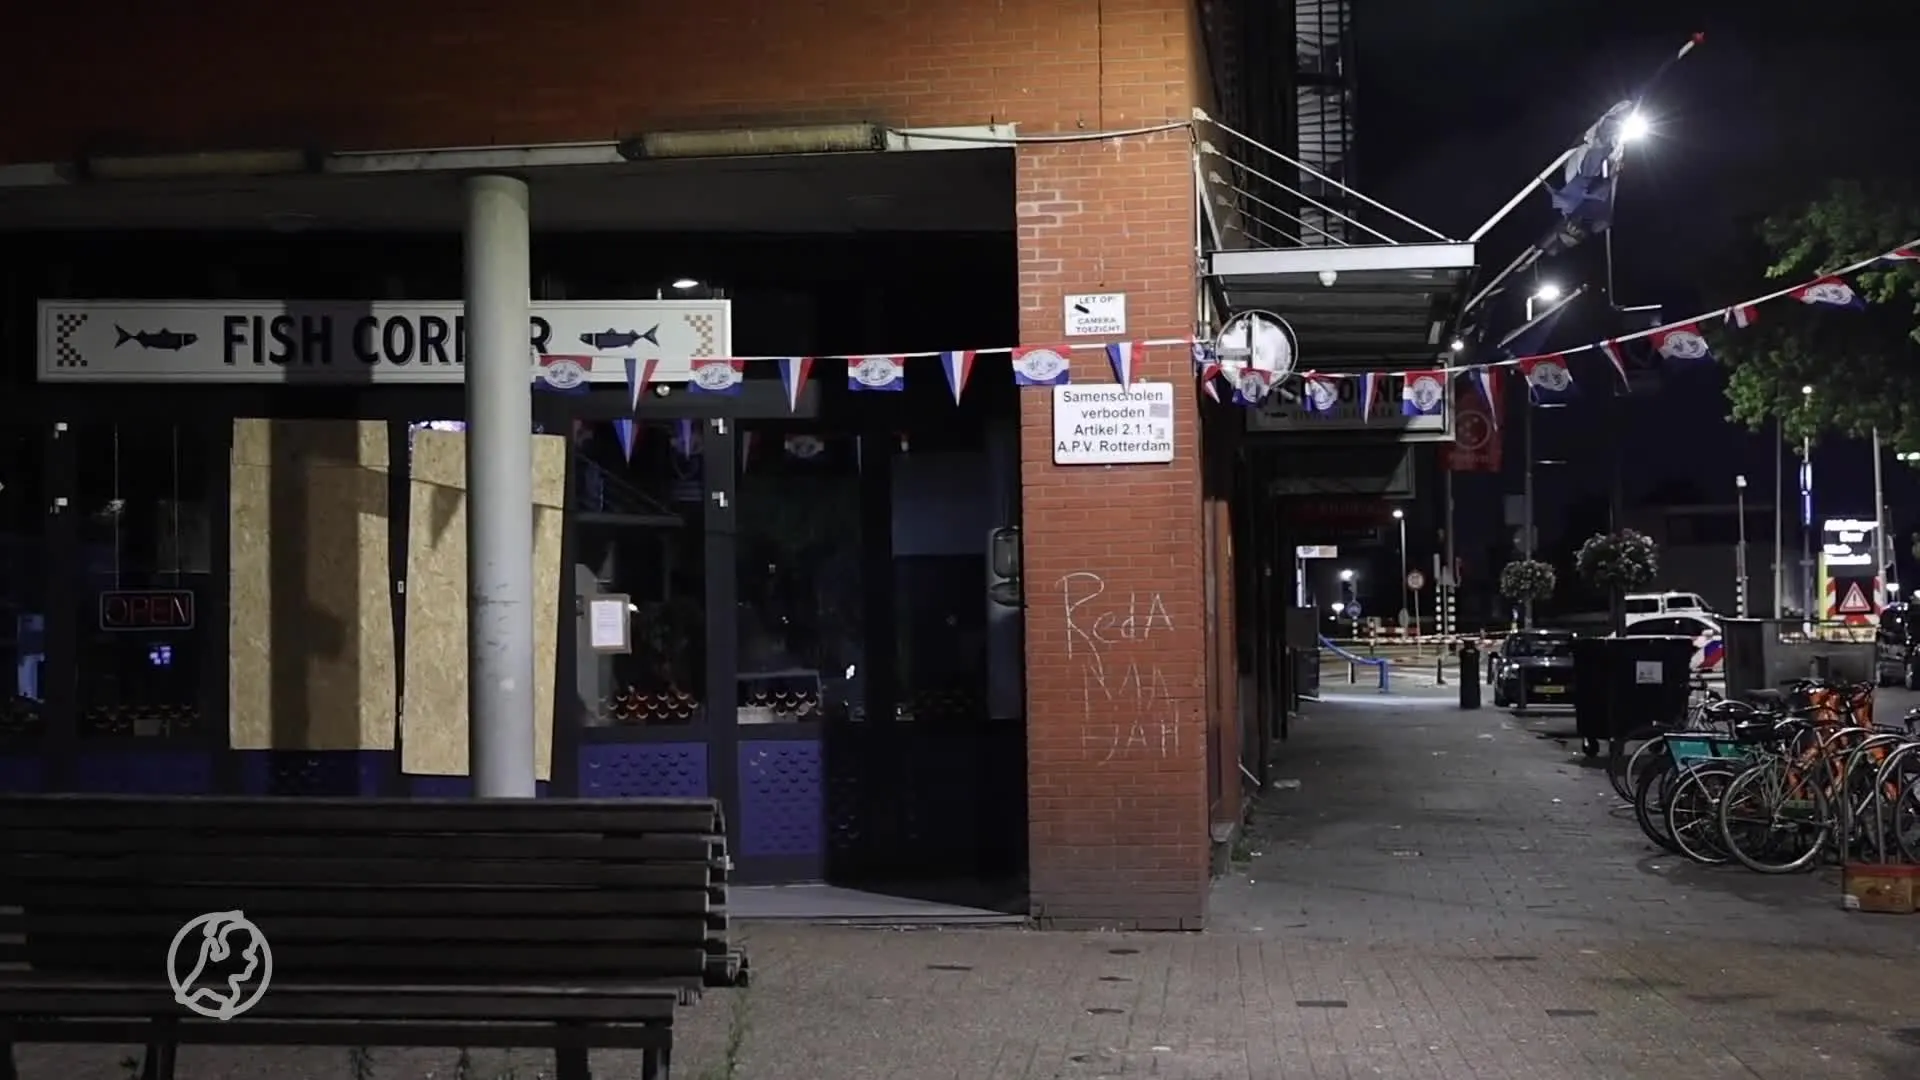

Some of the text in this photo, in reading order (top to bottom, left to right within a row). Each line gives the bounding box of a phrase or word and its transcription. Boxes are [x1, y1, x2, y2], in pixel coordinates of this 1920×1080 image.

[1077, 317, 1117, 325] CAMERA
[1075, 326, 1122, 334] TOEZICHT
[223, 317, 552, 365] FISH CORR
[1063, 390, 1163, 403] Samenscholen
[1081, 407, 1145, 419] verboden
[1074, 424, 1118, 436] Artikel
[1100, 440, 1171, 452] Rotterdam
[105, 596, 190, 625] OPEN
